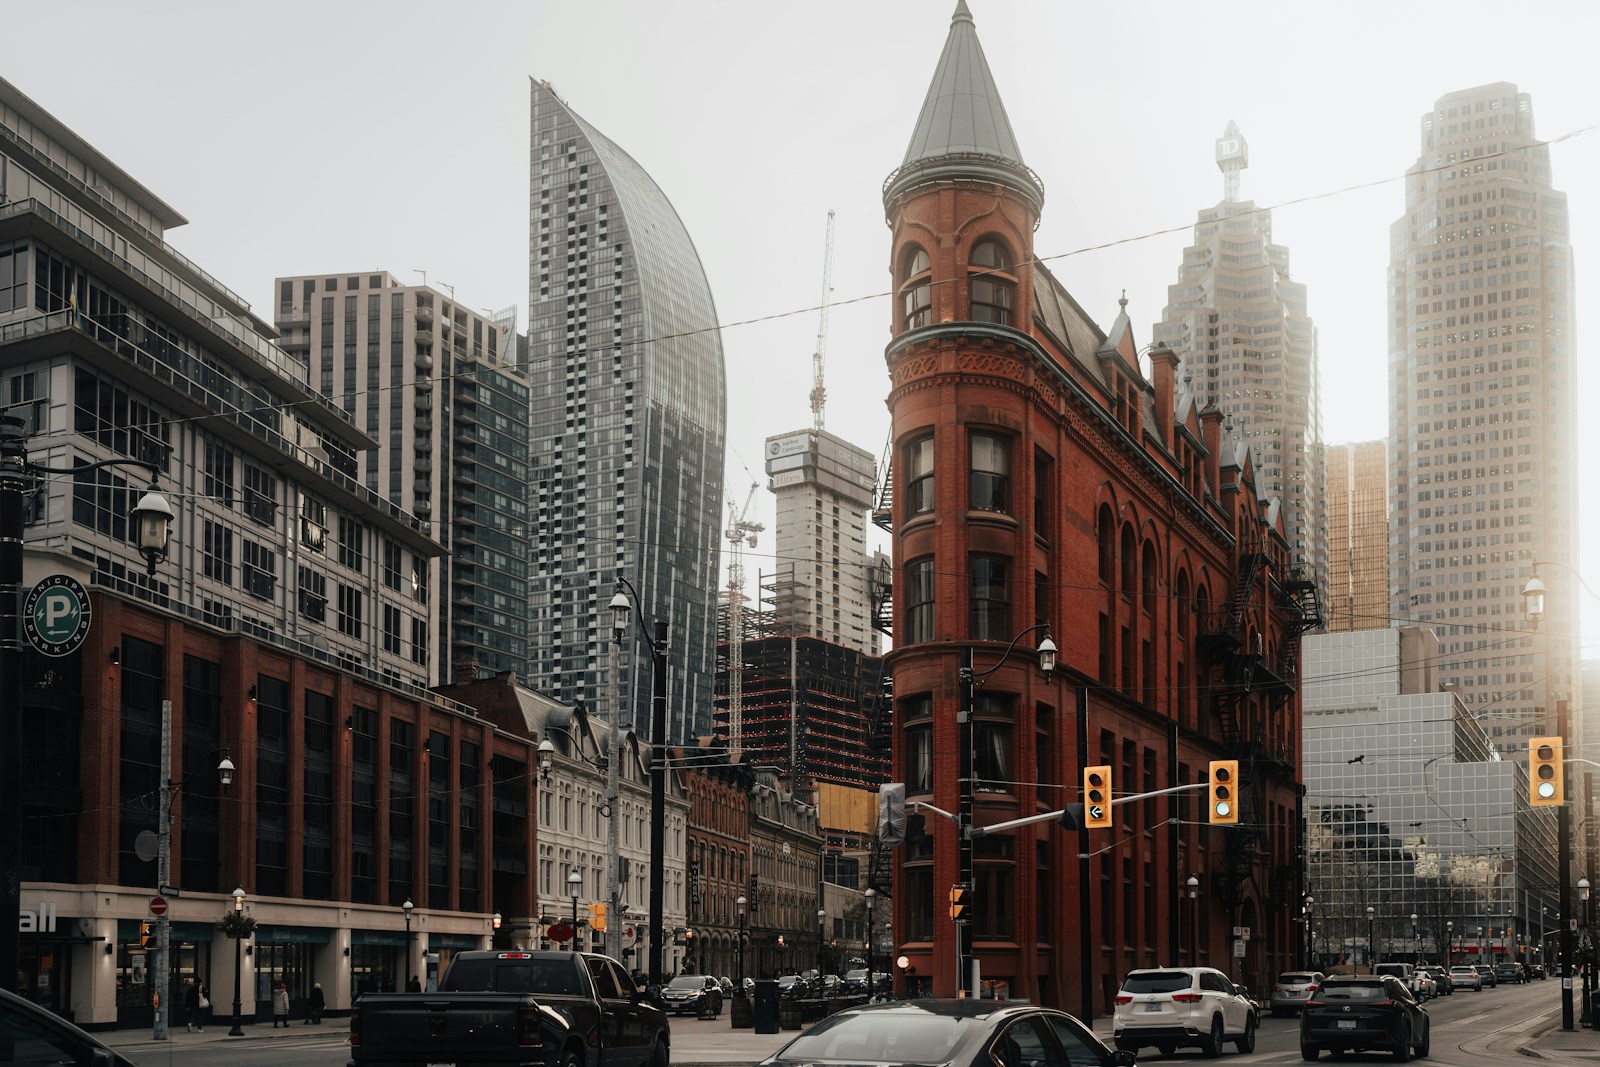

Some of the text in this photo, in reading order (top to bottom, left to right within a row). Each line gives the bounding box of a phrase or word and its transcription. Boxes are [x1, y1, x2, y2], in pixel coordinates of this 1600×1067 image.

[1218, 139, 1239, 155] TD
[27, 578, 87, 614] MUNICIPAL
[46, 595, 72, 628] P
[28, 621, 87, 653] PARKING
[691, 864, 699, 902] WINNERS
